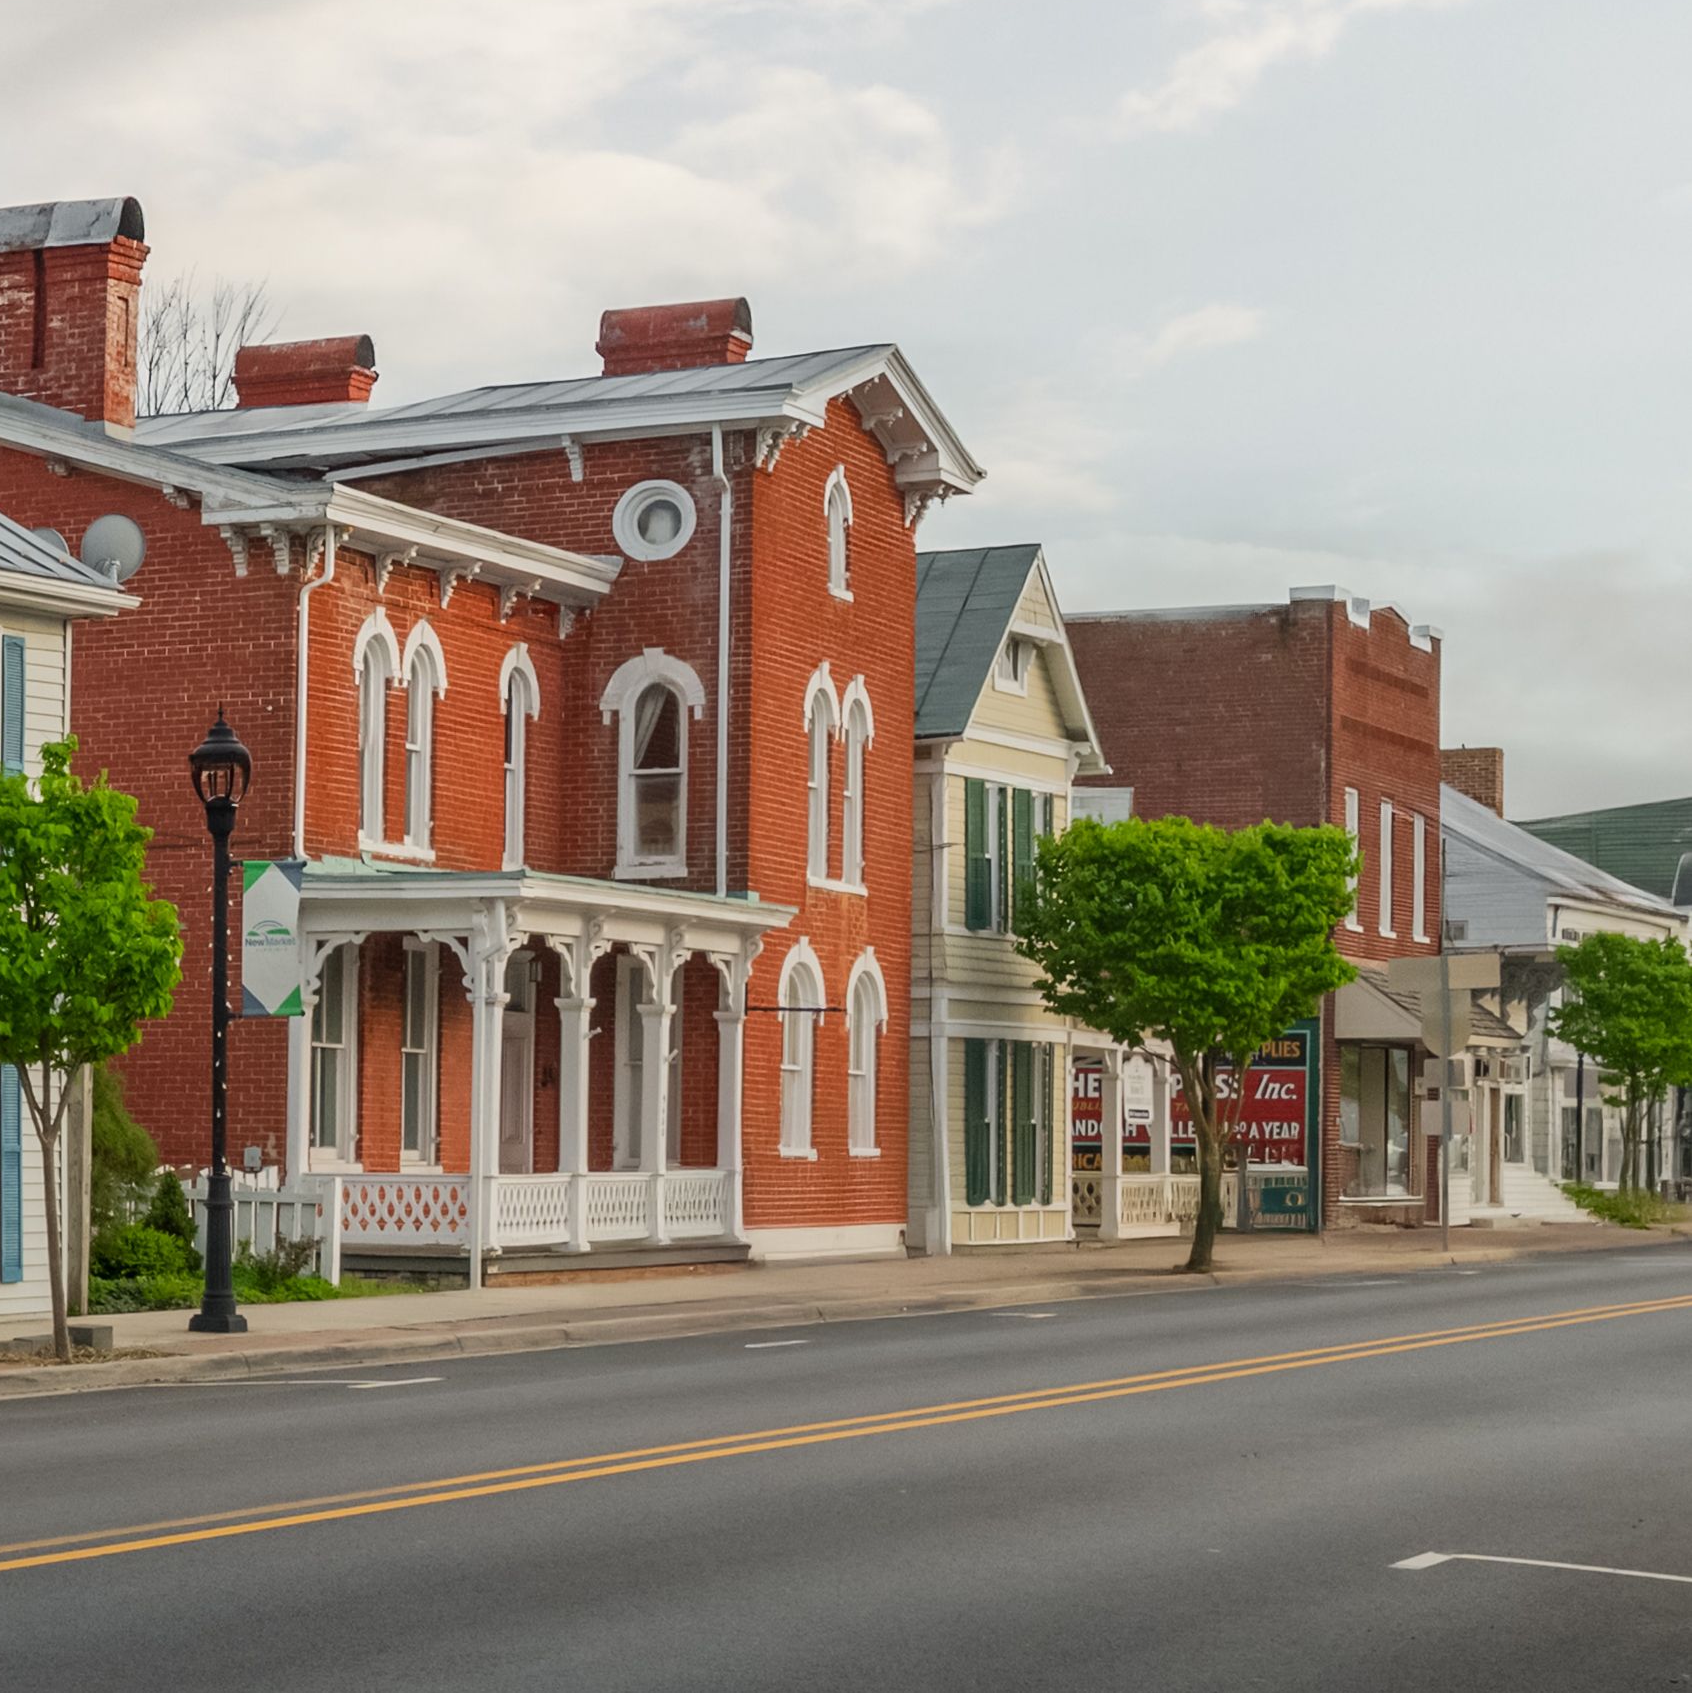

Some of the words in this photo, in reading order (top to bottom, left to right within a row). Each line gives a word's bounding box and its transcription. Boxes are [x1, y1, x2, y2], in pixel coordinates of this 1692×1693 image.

[245, 938, 265, 947] New
[265, 937, 296, 946] Market
[1254, 1073, 1298, 1100] Inc.
[1248, 1121, 1261, 1140] A
[1261, 1121, 1300, 1141] YEAR
